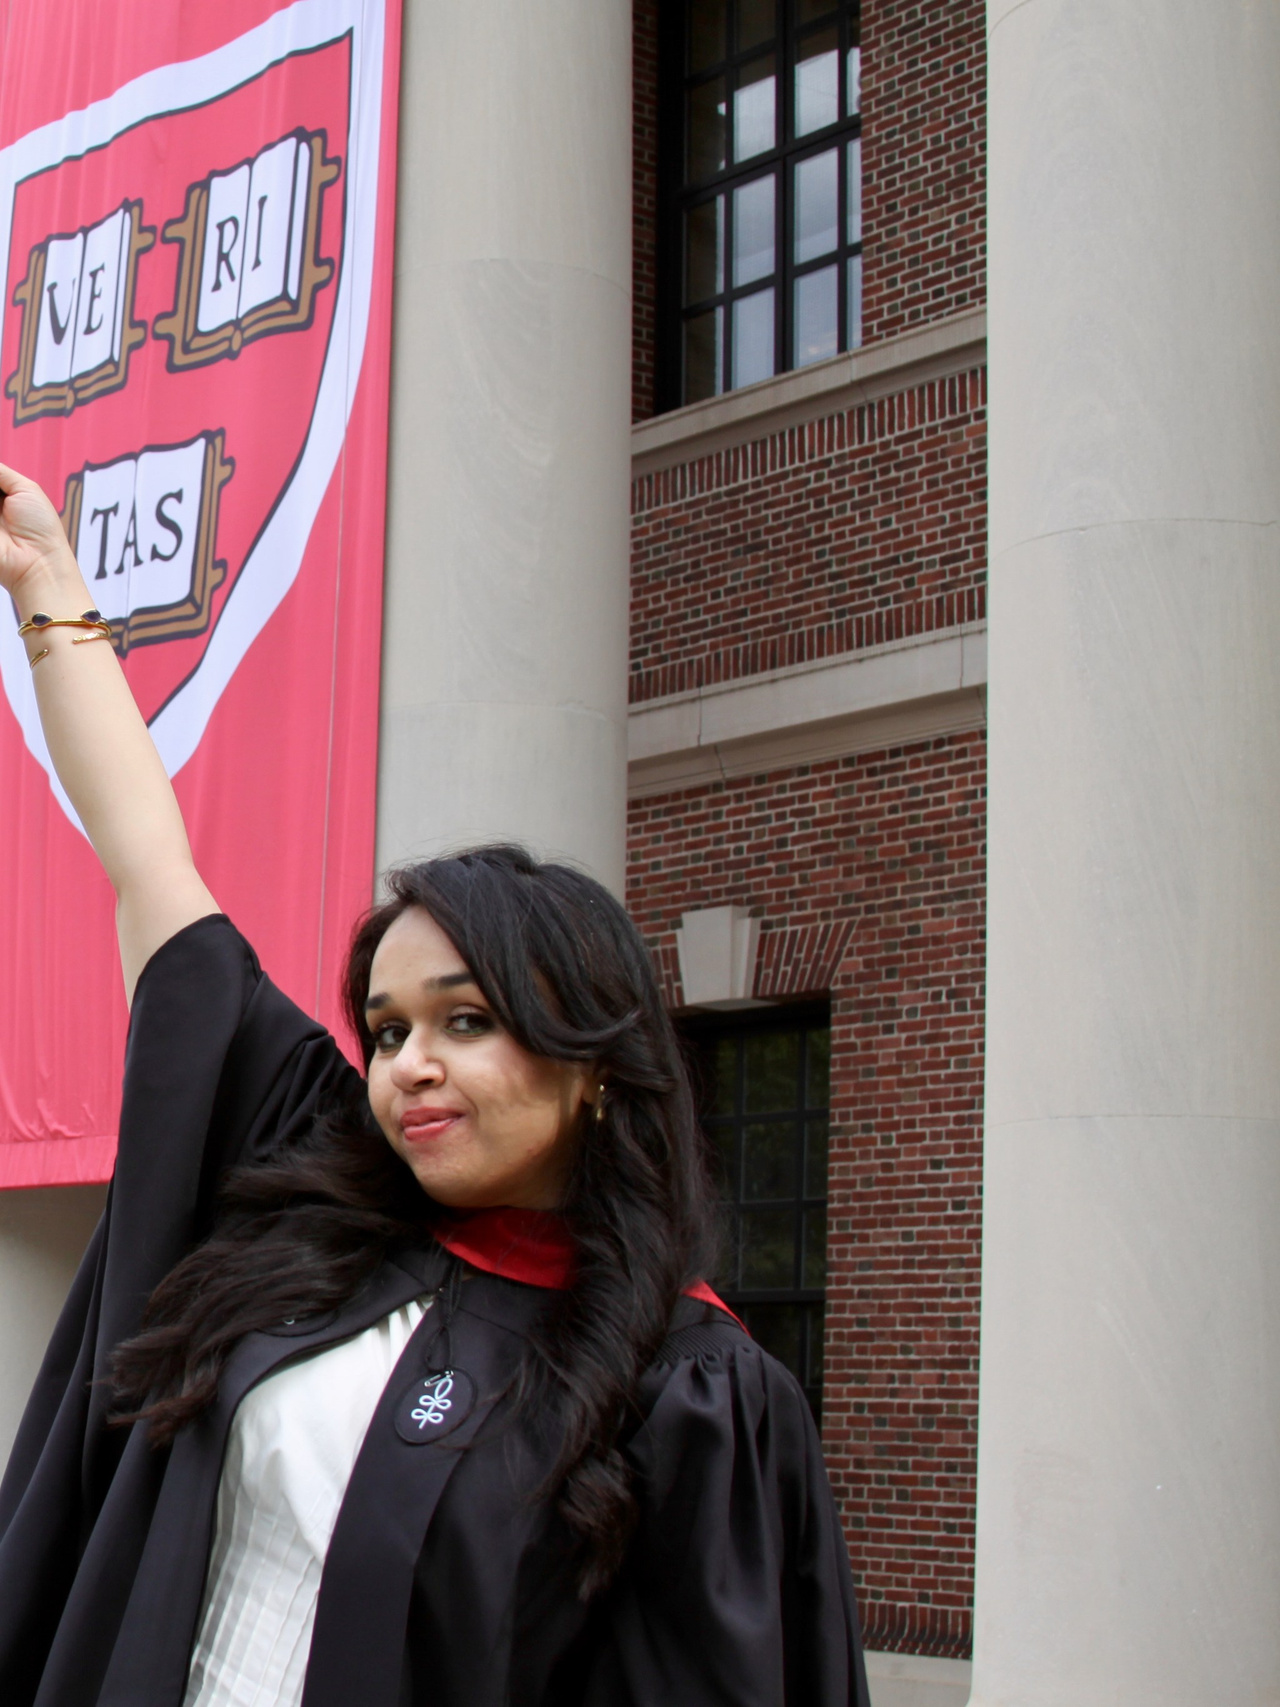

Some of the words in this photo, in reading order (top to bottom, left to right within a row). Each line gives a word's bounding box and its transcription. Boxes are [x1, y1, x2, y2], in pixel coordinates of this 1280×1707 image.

[47, 261, 106, 346] VE
[211, 194, 269, 294] RI
[89, 487, 184, 581] TAS
